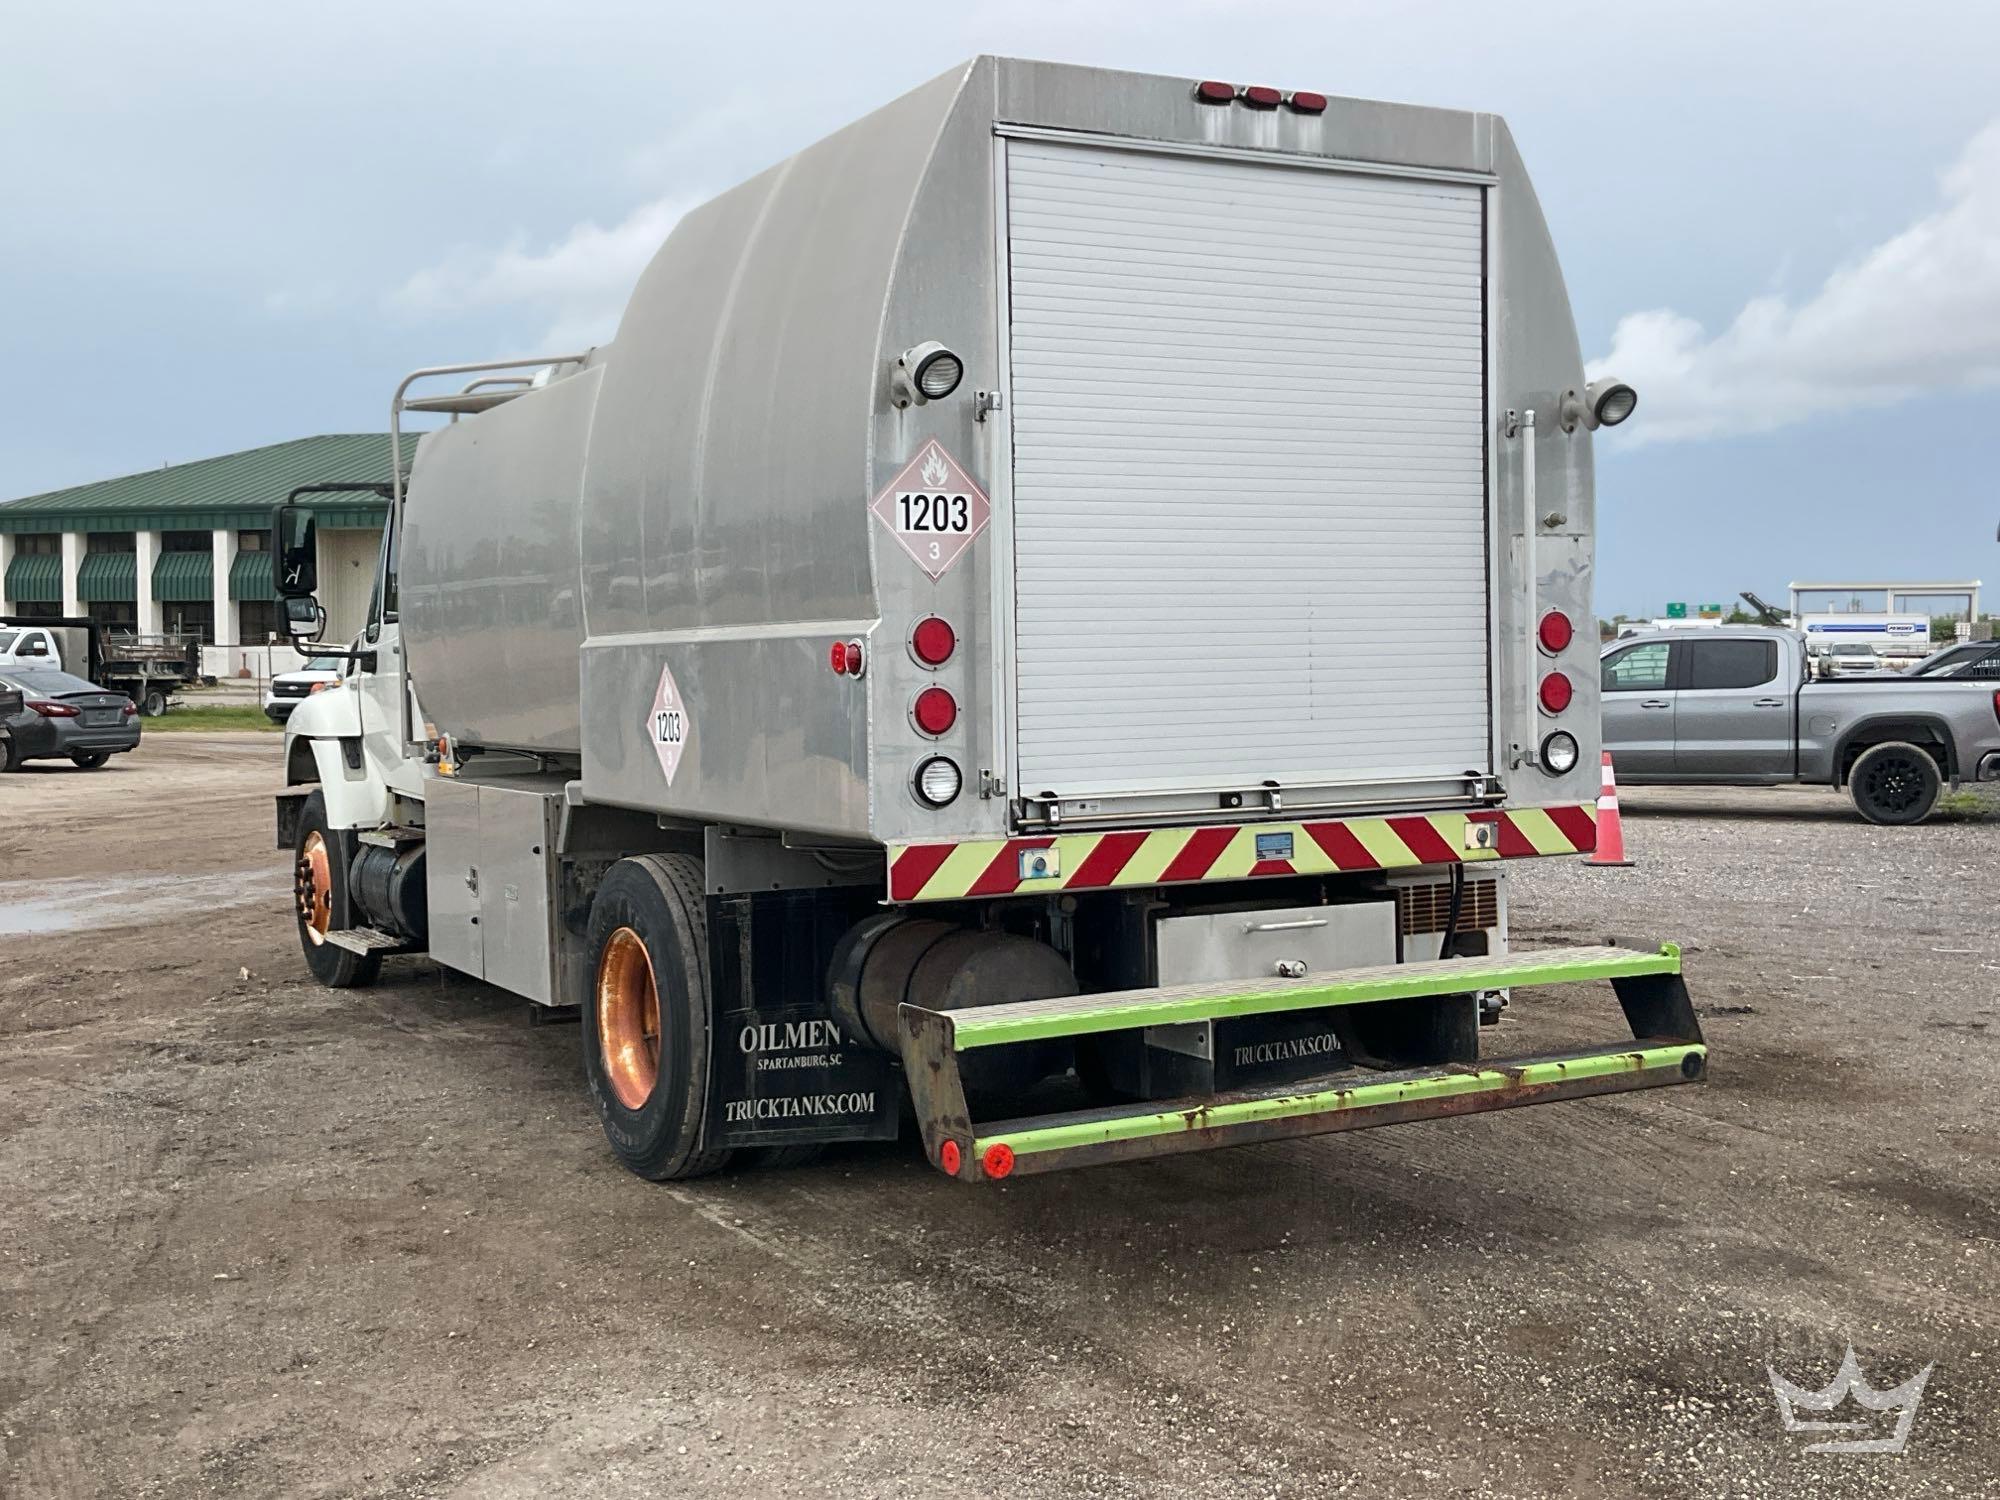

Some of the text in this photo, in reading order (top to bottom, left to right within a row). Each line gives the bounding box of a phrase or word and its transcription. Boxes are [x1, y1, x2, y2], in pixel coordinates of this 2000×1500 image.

[900, 494, 968, 532] 1203
[928, 541, 941, 560] 3
[657, 712, 681, 742] 1203
[739, 1019, 858, 1053] OILMEN
[757, 1053, 842, 1070] SPARTANBURG, SC
[725, 1092, 875, 1121] TRUCKTANKS.COM
